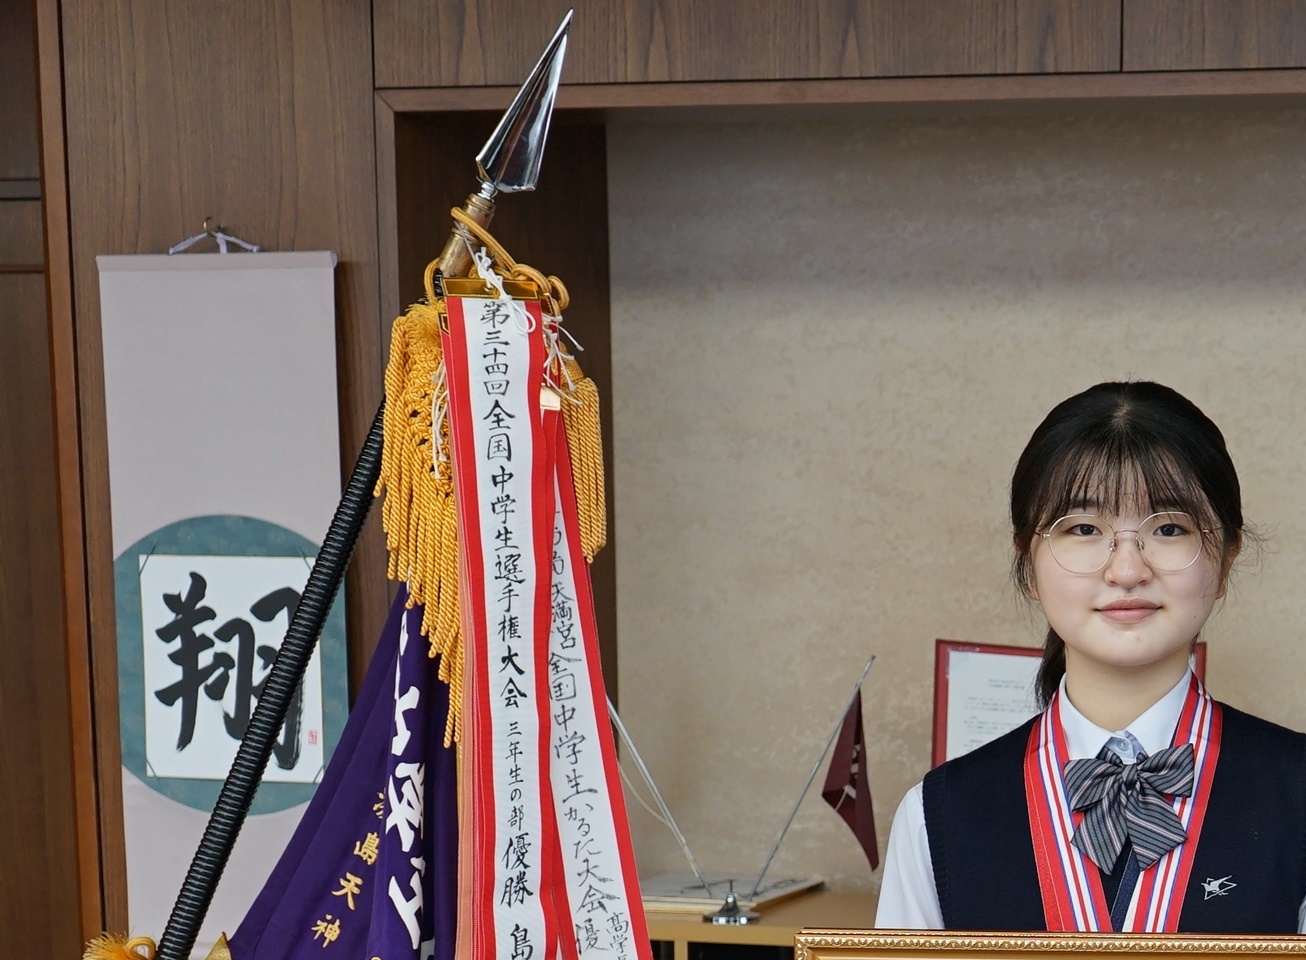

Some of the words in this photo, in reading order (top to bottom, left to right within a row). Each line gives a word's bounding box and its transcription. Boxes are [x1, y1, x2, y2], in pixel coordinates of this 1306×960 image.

[480, 302, 527, 708] 第三十四回全国中学生選手権大会
[505, 721, 524, 831] 三年生の部
[500, 832, 534, 908] 優勝
